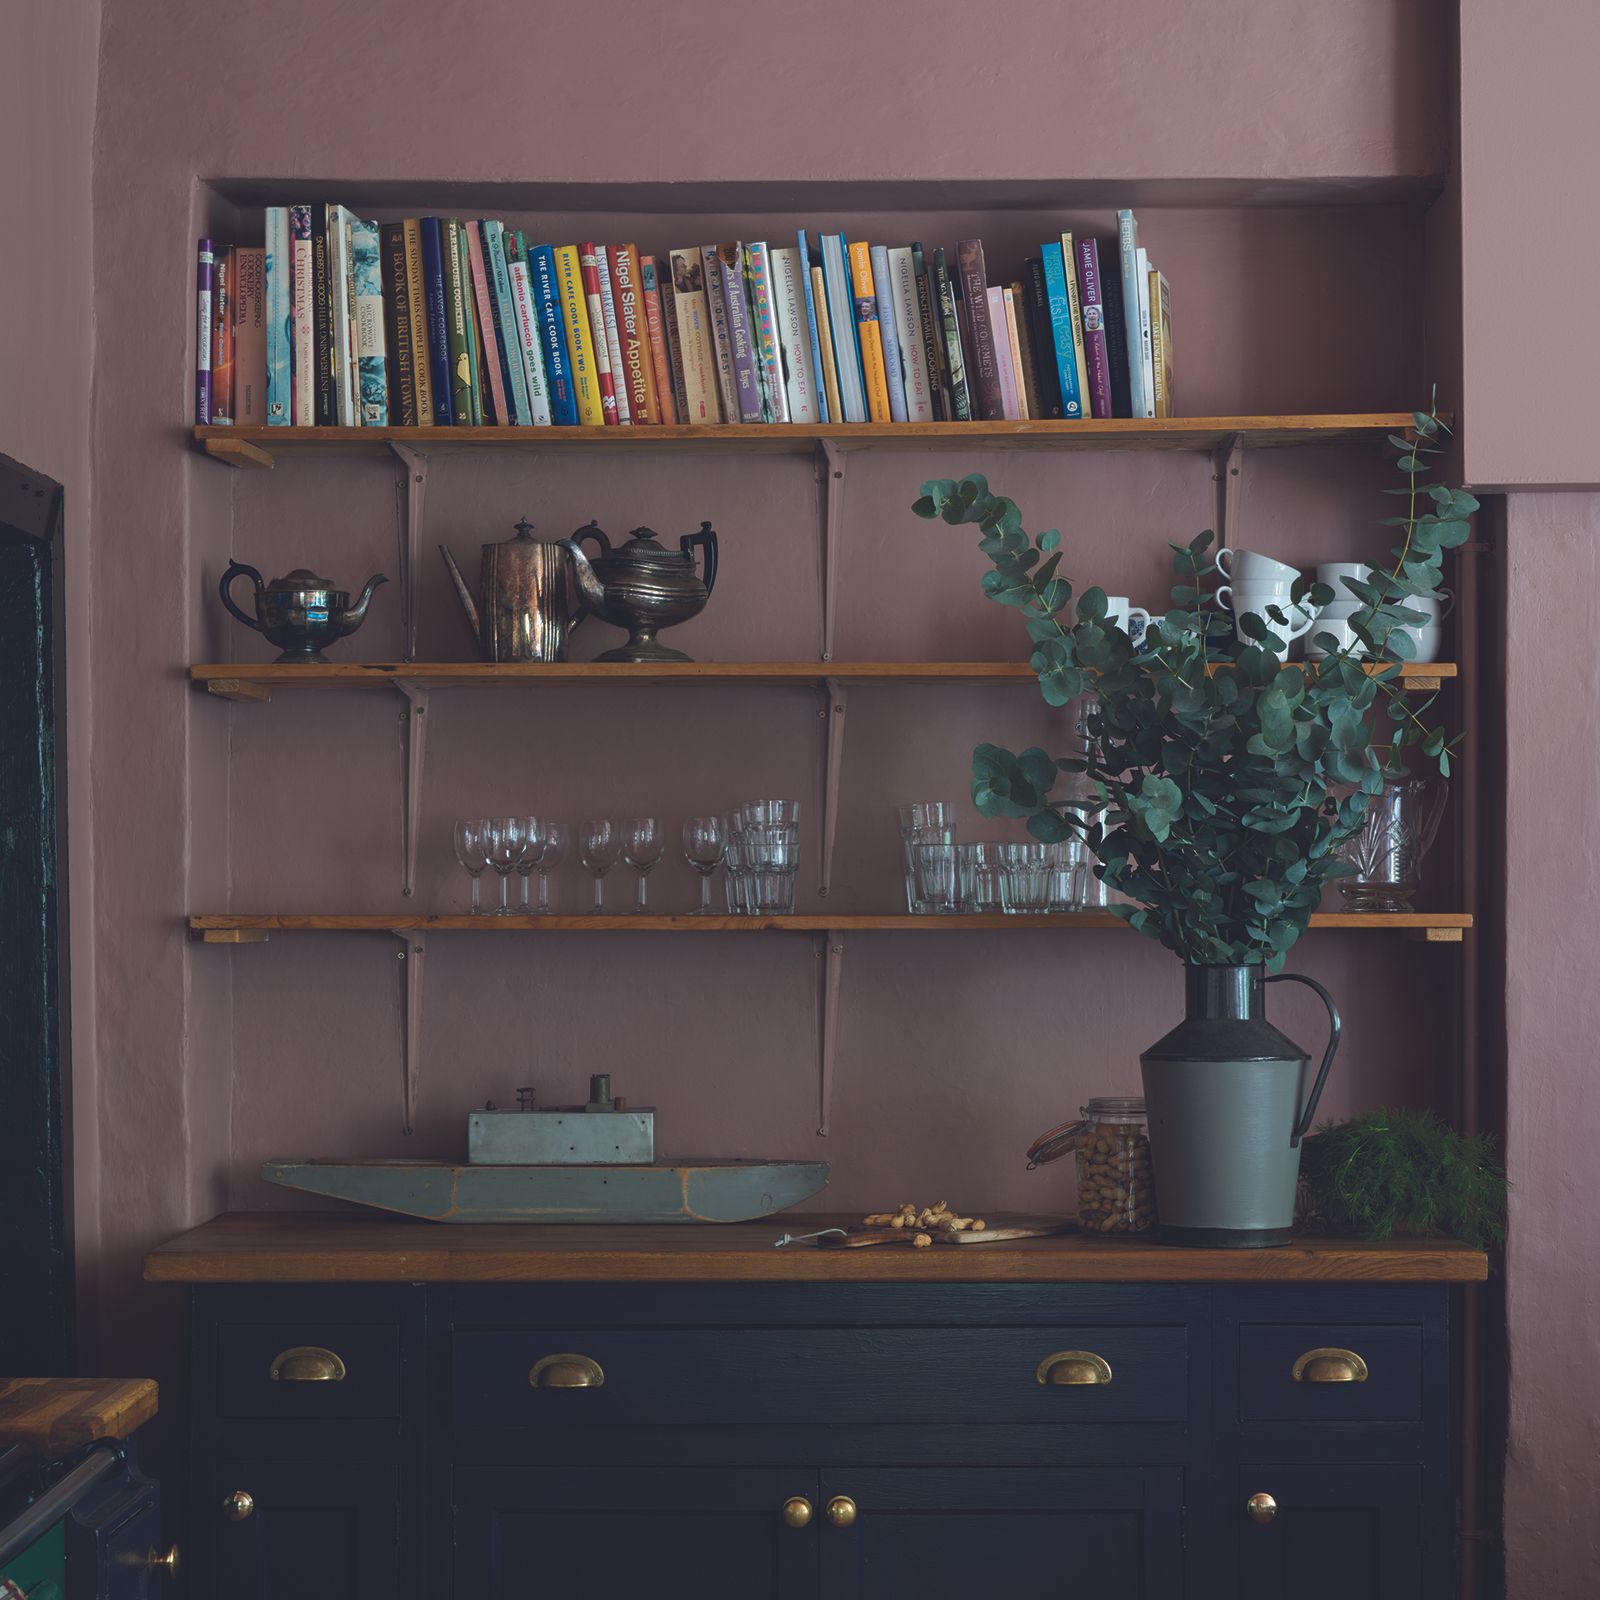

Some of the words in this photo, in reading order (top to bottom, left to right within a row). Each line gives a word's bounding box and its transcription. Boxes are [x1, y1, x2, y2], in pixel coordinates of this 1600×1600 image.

[409, 228, 417, 245] THE
[491, 233, 499, 242] The
[1121, 218, 1132, 252] HERBS
[316, 236, 325, 281] HOUSEKEEPING
[410, 247, 419, 284] SUNDAY
[449, 224, 460, 288] FARMHOUSE
[539, 256, 548, 272] THE
[563, 254, 573, 277] RIVER
[856, 247, 866, 269] Jamie
[1082, 243, 1092, 268] JAMIE
[393, 253, 406, 292] BOOK
[597, 254, 610, 285] ISLAND
[616, 251, 633, 288] Nigel
[783, 257, 794, 294] NIGELLA
[900, 258, 911, 294] NIGELLA
[937, 267, 945, 280] THE
[297, 248, 306, 319] CHRISTMAS
[317, 282, 326, 305] GOOD
[513, 266, 527, 302] antonio
[542, 274, 552, 299] RIVER
[566, 280, 576, 299] CAFE
[859, 271, 868, 294] Oliver
[916, 276, 929, 310] FRENCH
[939, 282, 948, 296] AGA
[970, 272, 982, 293] THE
[1085, 272, 1095, 302] OLIVER
[396, 295, 407, 311] OF
[413, 288, 421, 313] TIMES
[436, 291, 444, 314] SAVOY
[453, 289, 463, 335] COOKERY
[545, 302, 555, 322] CAFE
[602, 290, 615, 330] HARVEST
[729, 290, 743, 328] Australian
[973, 296, 986, 322] WILD
[318, 306, 326, 329] WITH
[519, 304, 534, 347] carluccio
[569, 302, 579, 325] COOK
[621, 292, 639, 335] Slater
[692, 311, 700, 330] RIVER
[787, 298, 799, 336] LAWSON
[904, 298, 916, 336] LAWSON
[1049, 296, 1070, 331] fish
[366, 304, 374, 349] MICROWAVE
[414, 315, 424, 358] COMPLETE
[438, 317, 447, 361] COOKBOOK
[548, 325, 559, 349] COOK
[921, 313, 933, 344] FAMILY
[1152, 321, 1160, 338] CAKE
[397, 314, 410, 370] BRITISH
[573, 328, 583, 351] BOOK
[695, 332, 703, 361] COTTAGE
[733, 330, 746, 358] Cooking
[977, 324, 993, 378] GOURMETS
[1057, 326, 1073, 358] easy
[1153, 339, 1161, 356] ICING
[319, 330, 328, 390] ENTERTAINING
[526, 350, 538, 372] goes
[552, 351, 563, 376] BOOK
[576, 354, 586, 372] TWO
[793, 344, 802, 364] HOW
[910, 345, 919, 364] HOW
[418, 362, 426, 387] COOK
[626, 339, 646, 403] Appetite
[740, 370, 751, 389] Hayes
[796, 368, 803, 378] TO
[913, 368, 920, 378] TO
[925, 347, 939, 391] COOKING
[1154, 362, 1163, 400] DECORATING
[531, 376, 542, 396] wild
[797, 382, 805, 395] EAT
[914, 382, 922, 395] EAT
[400, 375, 413, 425] TOWNS
[420, 390, 428, 415] BOOK
